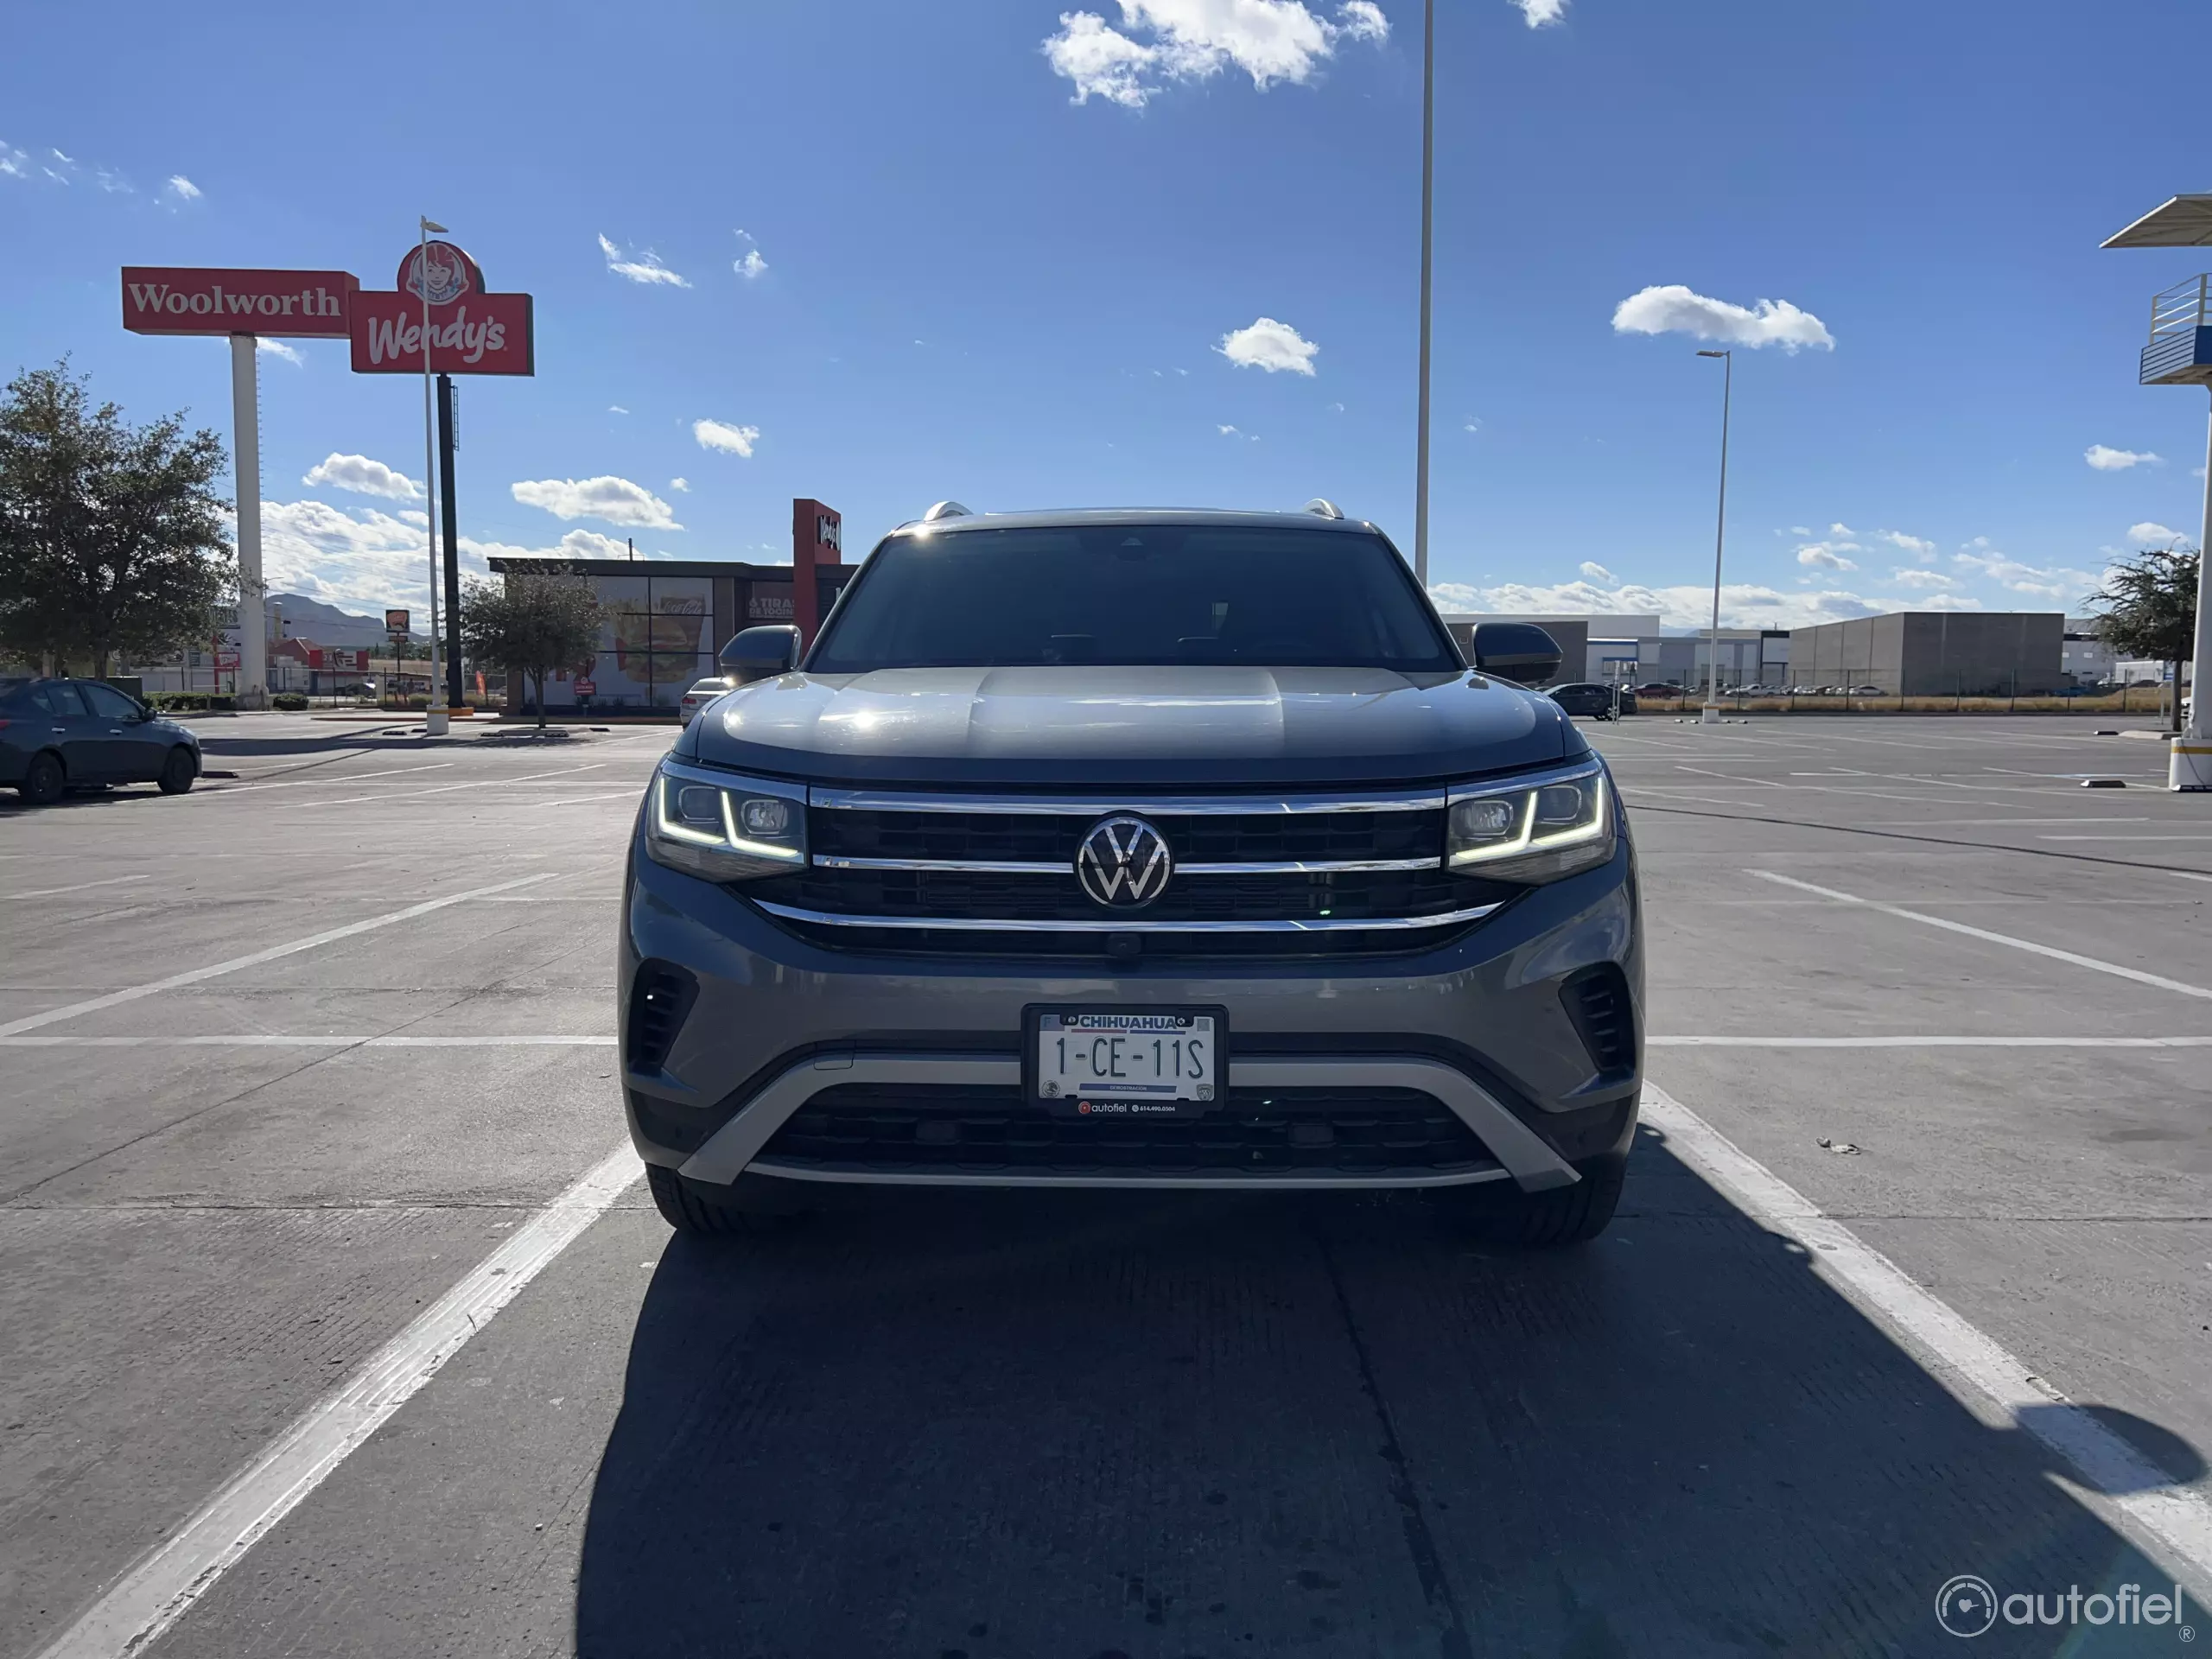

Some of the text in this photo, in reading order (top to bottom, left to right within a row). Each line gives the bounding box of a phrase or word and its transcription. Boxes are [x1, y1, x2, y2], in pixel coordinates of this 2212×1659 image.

[127, 283, 341, 317] Woolworth
[367, 305, 506, 365] Wendy's
[763, 607, 795, 616] TOCIN
[1079, 1015, 1178, 1030] CHIHUAHUA
[1056, 1036, 1205, 1079] 1-CE-11S
[1091, 1102, 1128, 1113] autofiel
